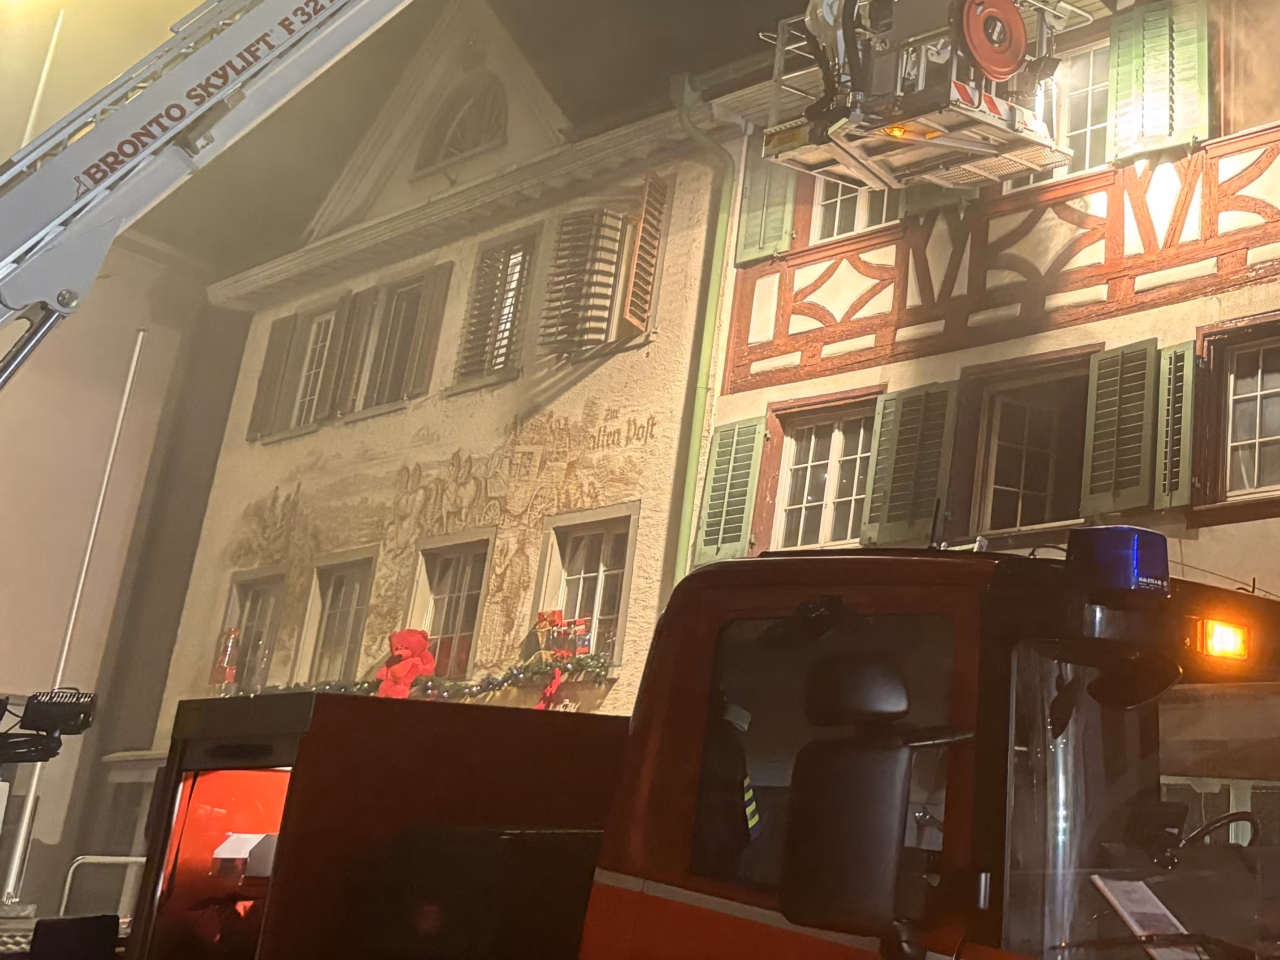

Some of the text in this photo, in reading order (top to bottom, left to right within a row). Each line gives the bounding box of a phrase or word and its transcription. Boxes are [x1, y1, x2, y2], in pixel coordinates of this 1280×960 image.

[82, 103, 187, 185] BRONTO
[186, 32, 276, 107] SKYLIFT
[625, 414, 657, 447] Post
